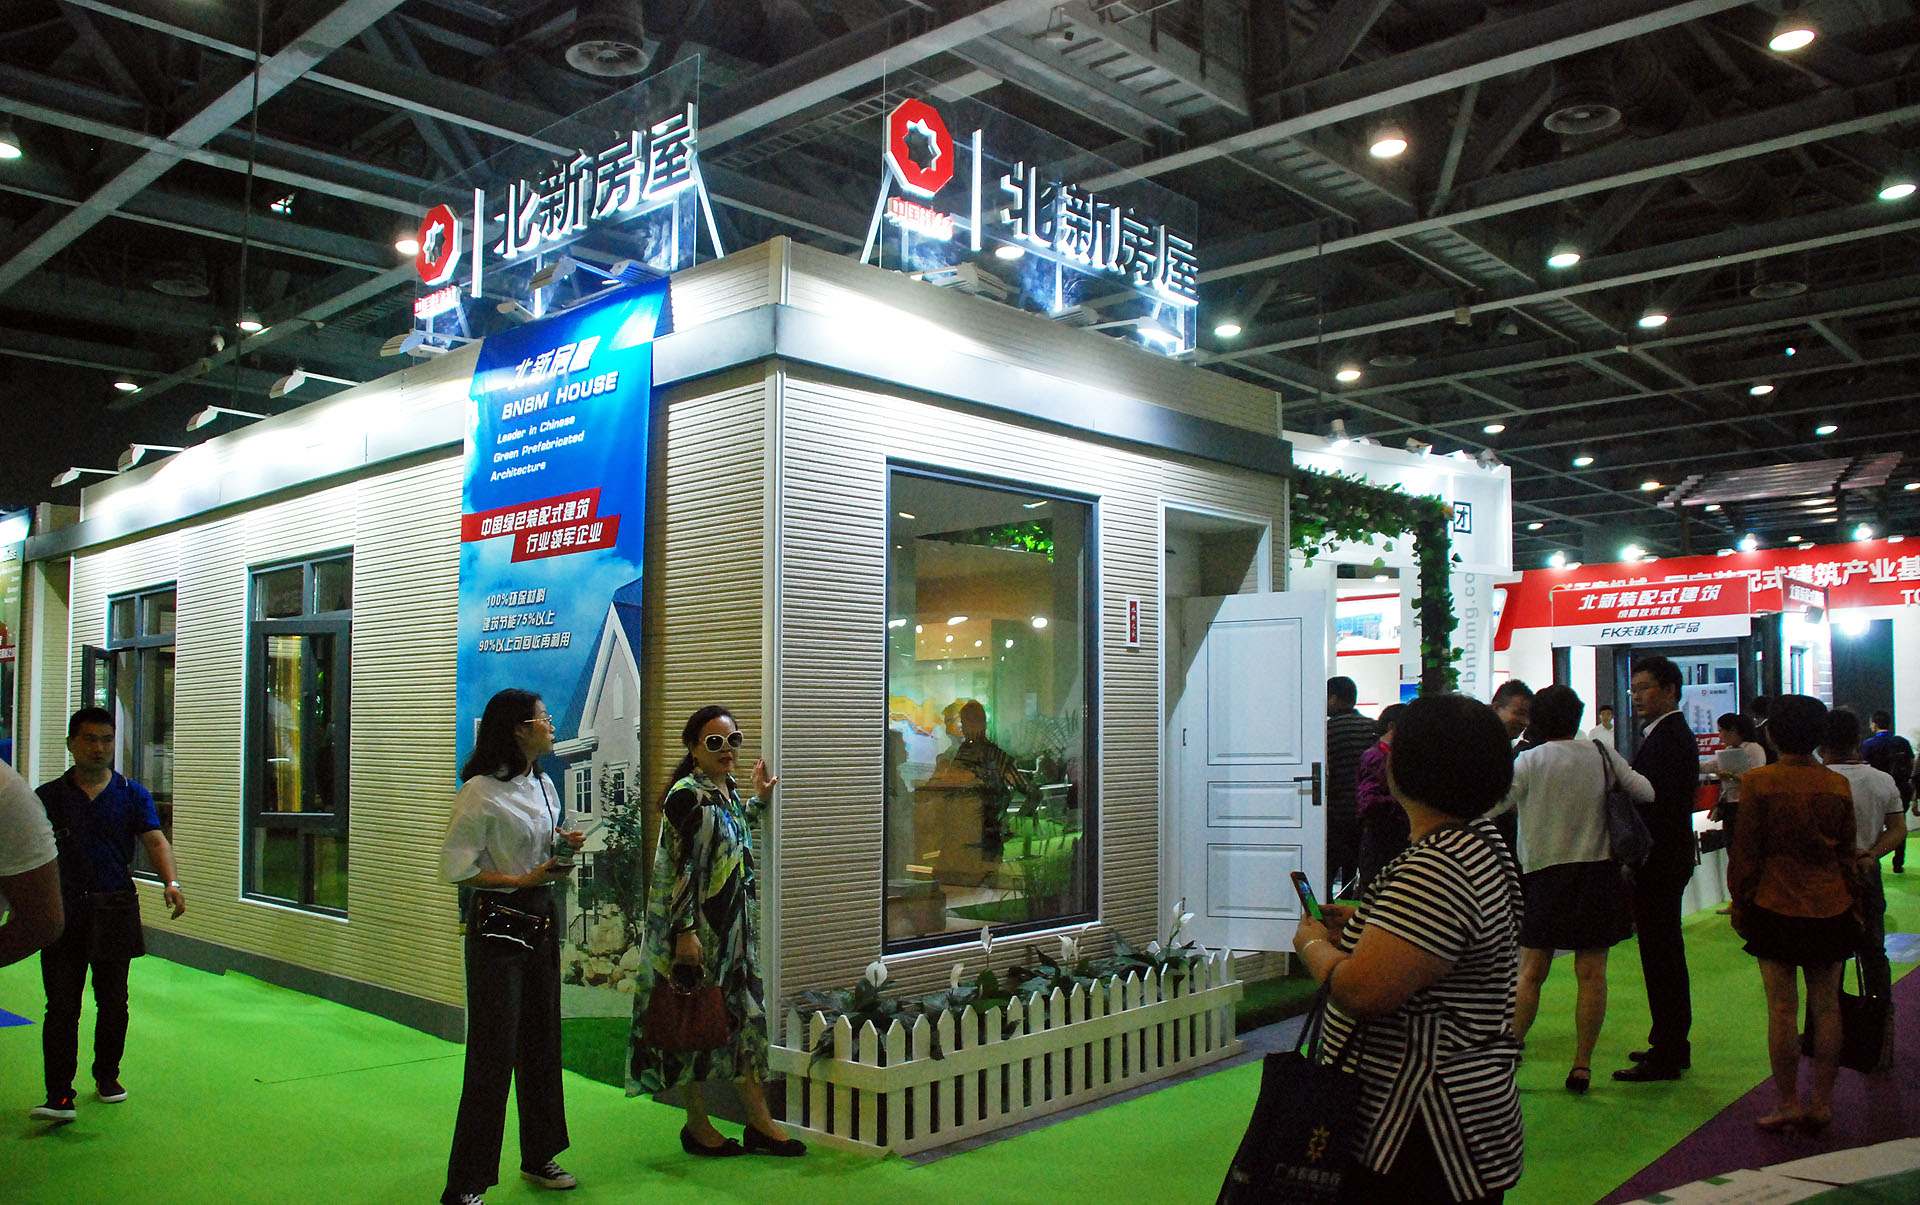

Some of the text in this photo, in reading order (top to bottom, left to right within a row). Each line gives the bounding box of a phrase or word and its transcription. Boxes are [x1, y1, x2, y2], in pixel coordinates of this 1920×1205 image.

[493, 102, 697, 260] 北新房屋
[1000, 160, 1199, 306] 北新房屋
[508, 335, 601, 390] 北新房屋
[502, 371, 620, 421] BNBM HOUSE
[493, 429, 585, 463] Green Prefabricated
[496, 415, 576, 445] Leader in Chinese
[490, 461, 547, 482] Architecture
[480, 497, 591, 537] 中国绿色装配式建筑
[525, 521, 604, 554] 行业领军企业
[486, 588, 547, 609] 100%环保材料
[1577, 584, 1723, 611] 北新装配式建筑
[482, 610, 556, 633] 建筑节能75%以上
[478, 631, 571, 654] 90%以上可回收再利用
